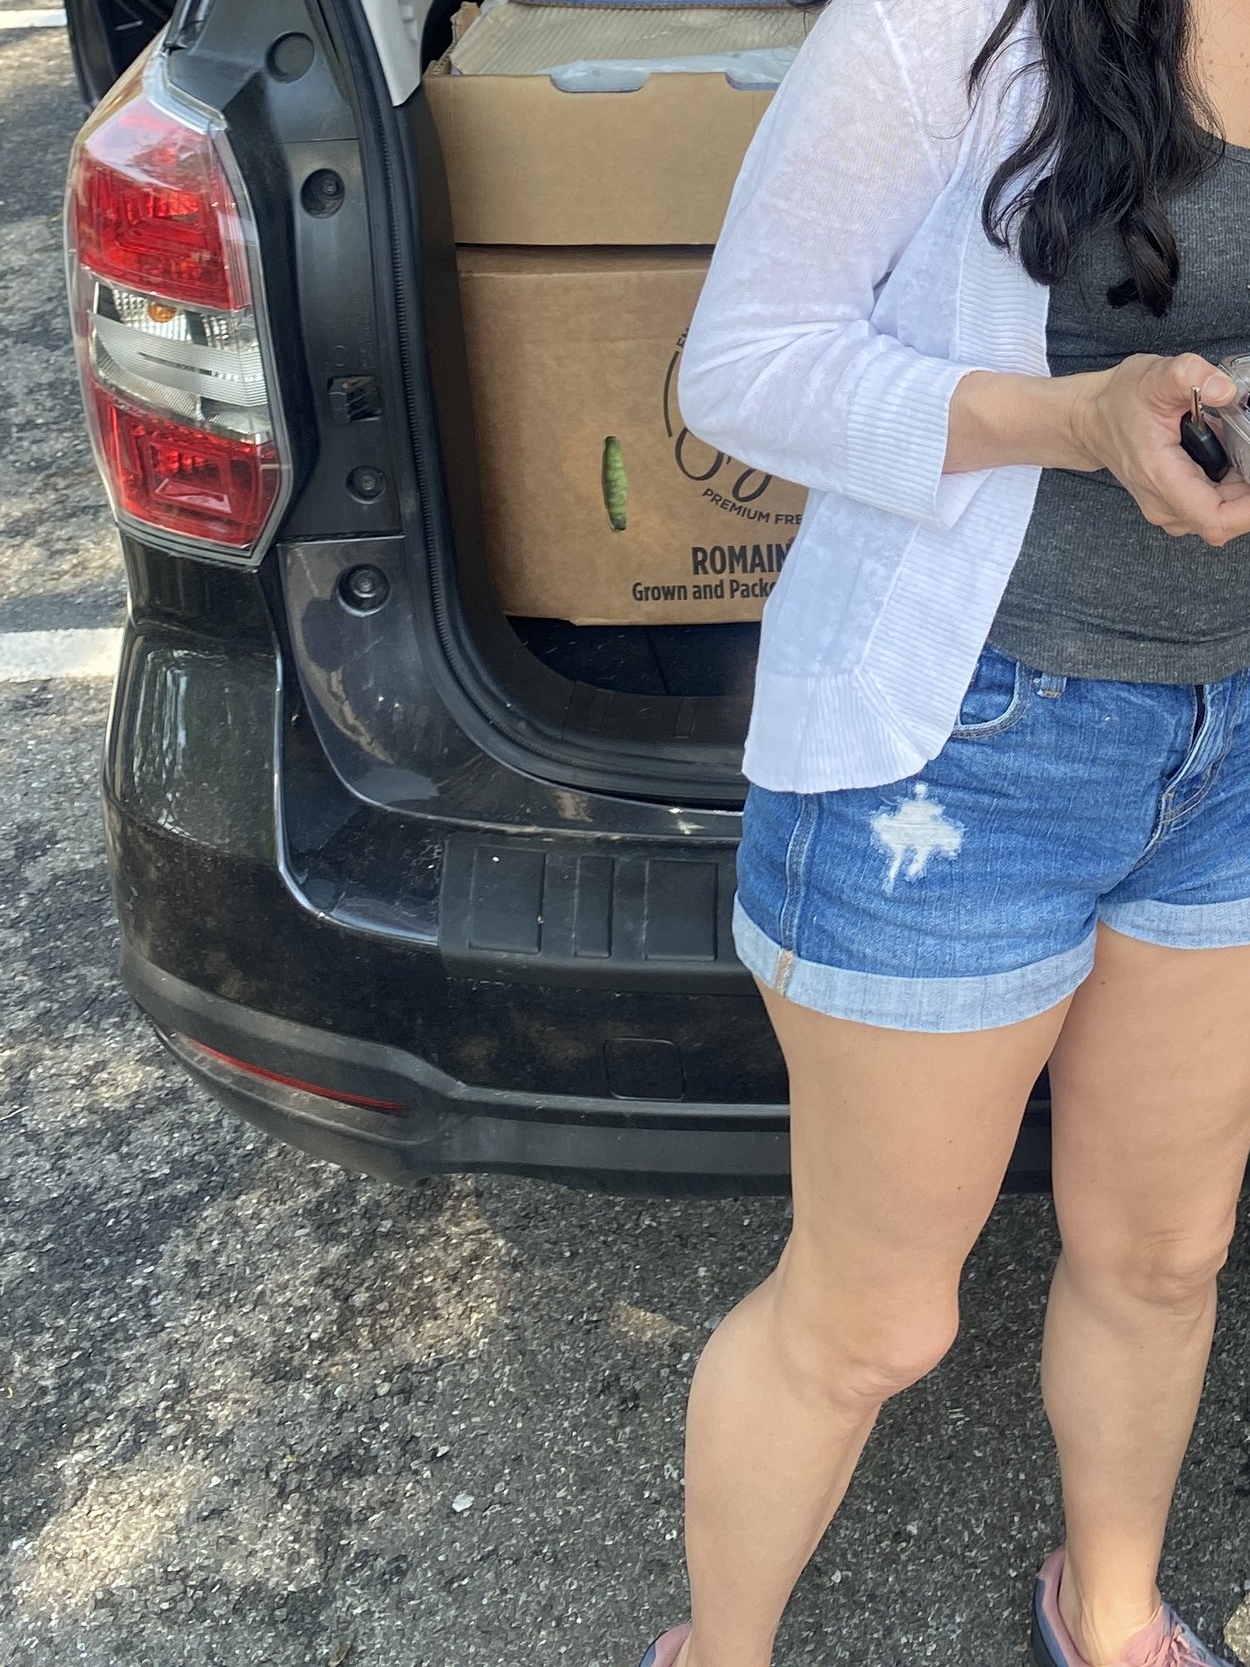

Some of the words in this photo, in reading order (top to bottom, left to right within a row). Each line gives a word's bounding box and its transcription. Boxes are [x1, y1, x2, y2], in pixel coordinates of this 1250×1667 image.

[701, 488, 771, 524] PREMIUM
[774, 514, 804, 526] FRE
[691, 543, 793, 576] ROMAIN
[632, 581, 688, 602] Grown
[691, 578, 725, 600] and
